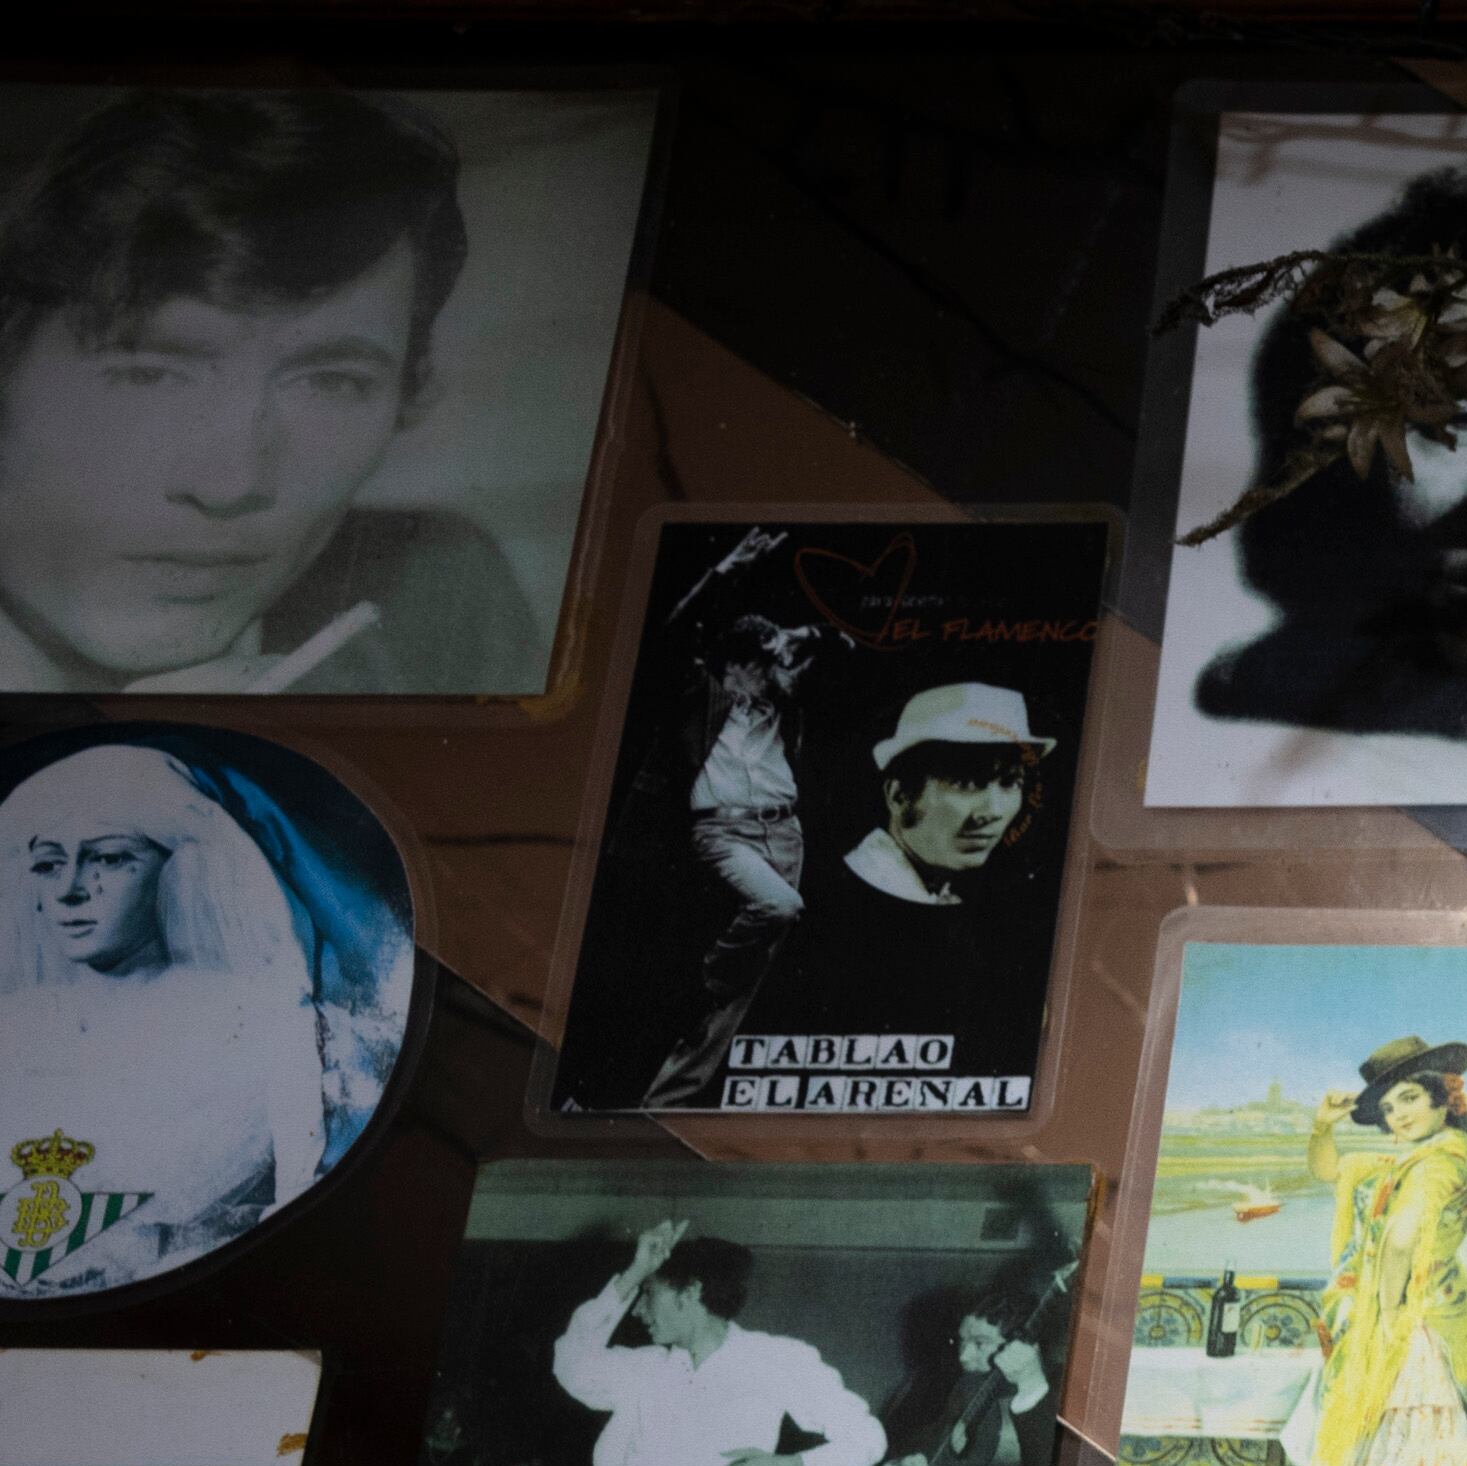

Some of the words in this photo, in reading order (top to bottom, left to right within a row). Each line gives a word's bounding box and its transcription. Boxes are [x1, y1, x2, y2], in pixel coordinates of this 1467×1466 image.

[892, 618, 931, 641] EL
[734, 1038, 949, 1066] TABLAO
[726, 1079, 793, 1107] EL
[808, 1079, 1024, 1108] ARENAL
